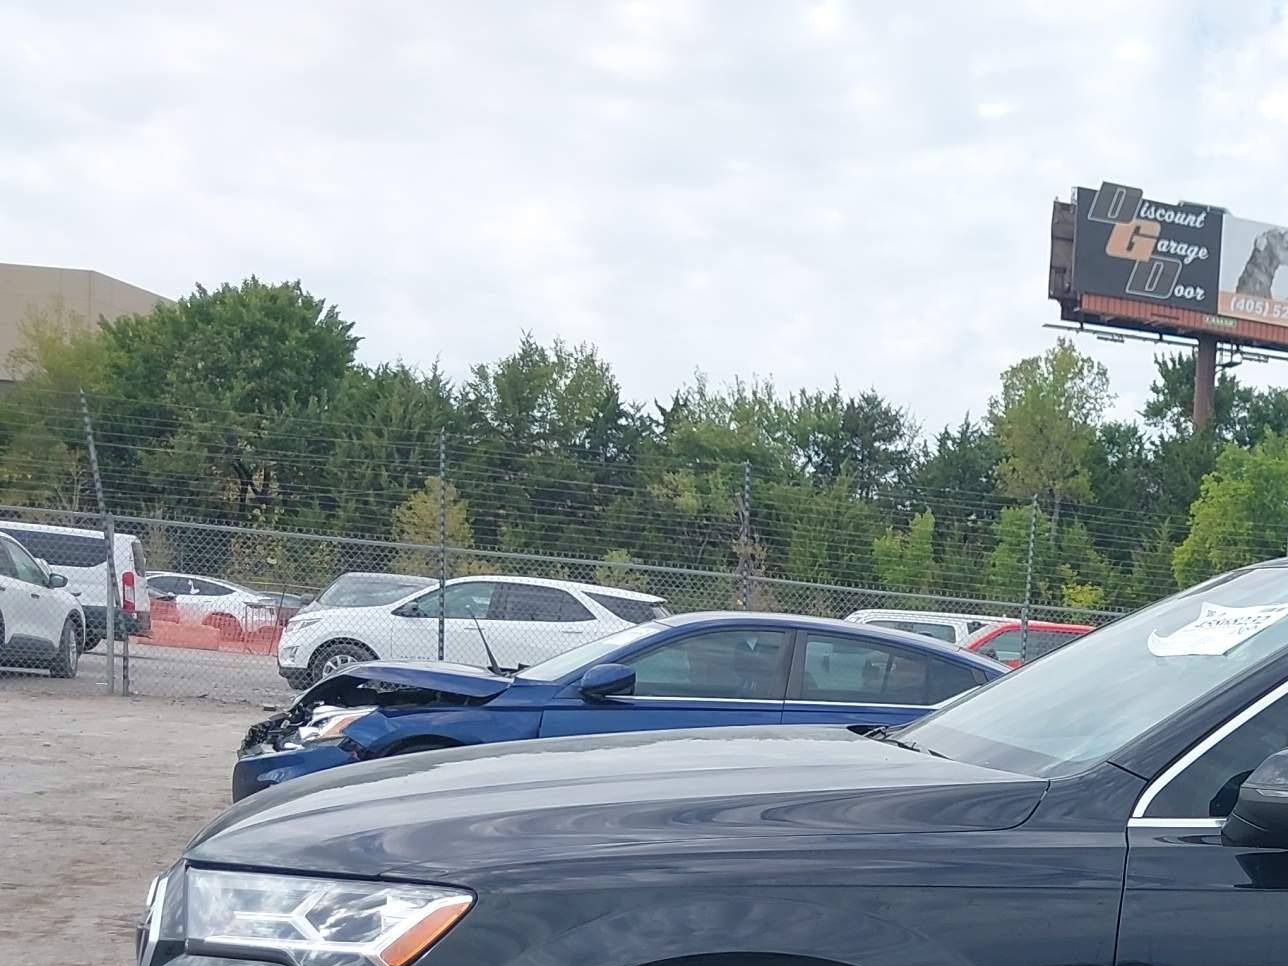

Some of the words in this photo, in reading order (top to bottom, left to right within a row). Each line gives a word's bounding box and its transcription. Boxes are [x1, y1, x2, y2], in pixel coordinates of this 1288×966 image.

[1088, 181, 1206, 229] Discount
[1105, 219, 1209, 264] Garage
[1125, 255, 1206, 300] Door
[1230, 295, 1270, 317] (405)
